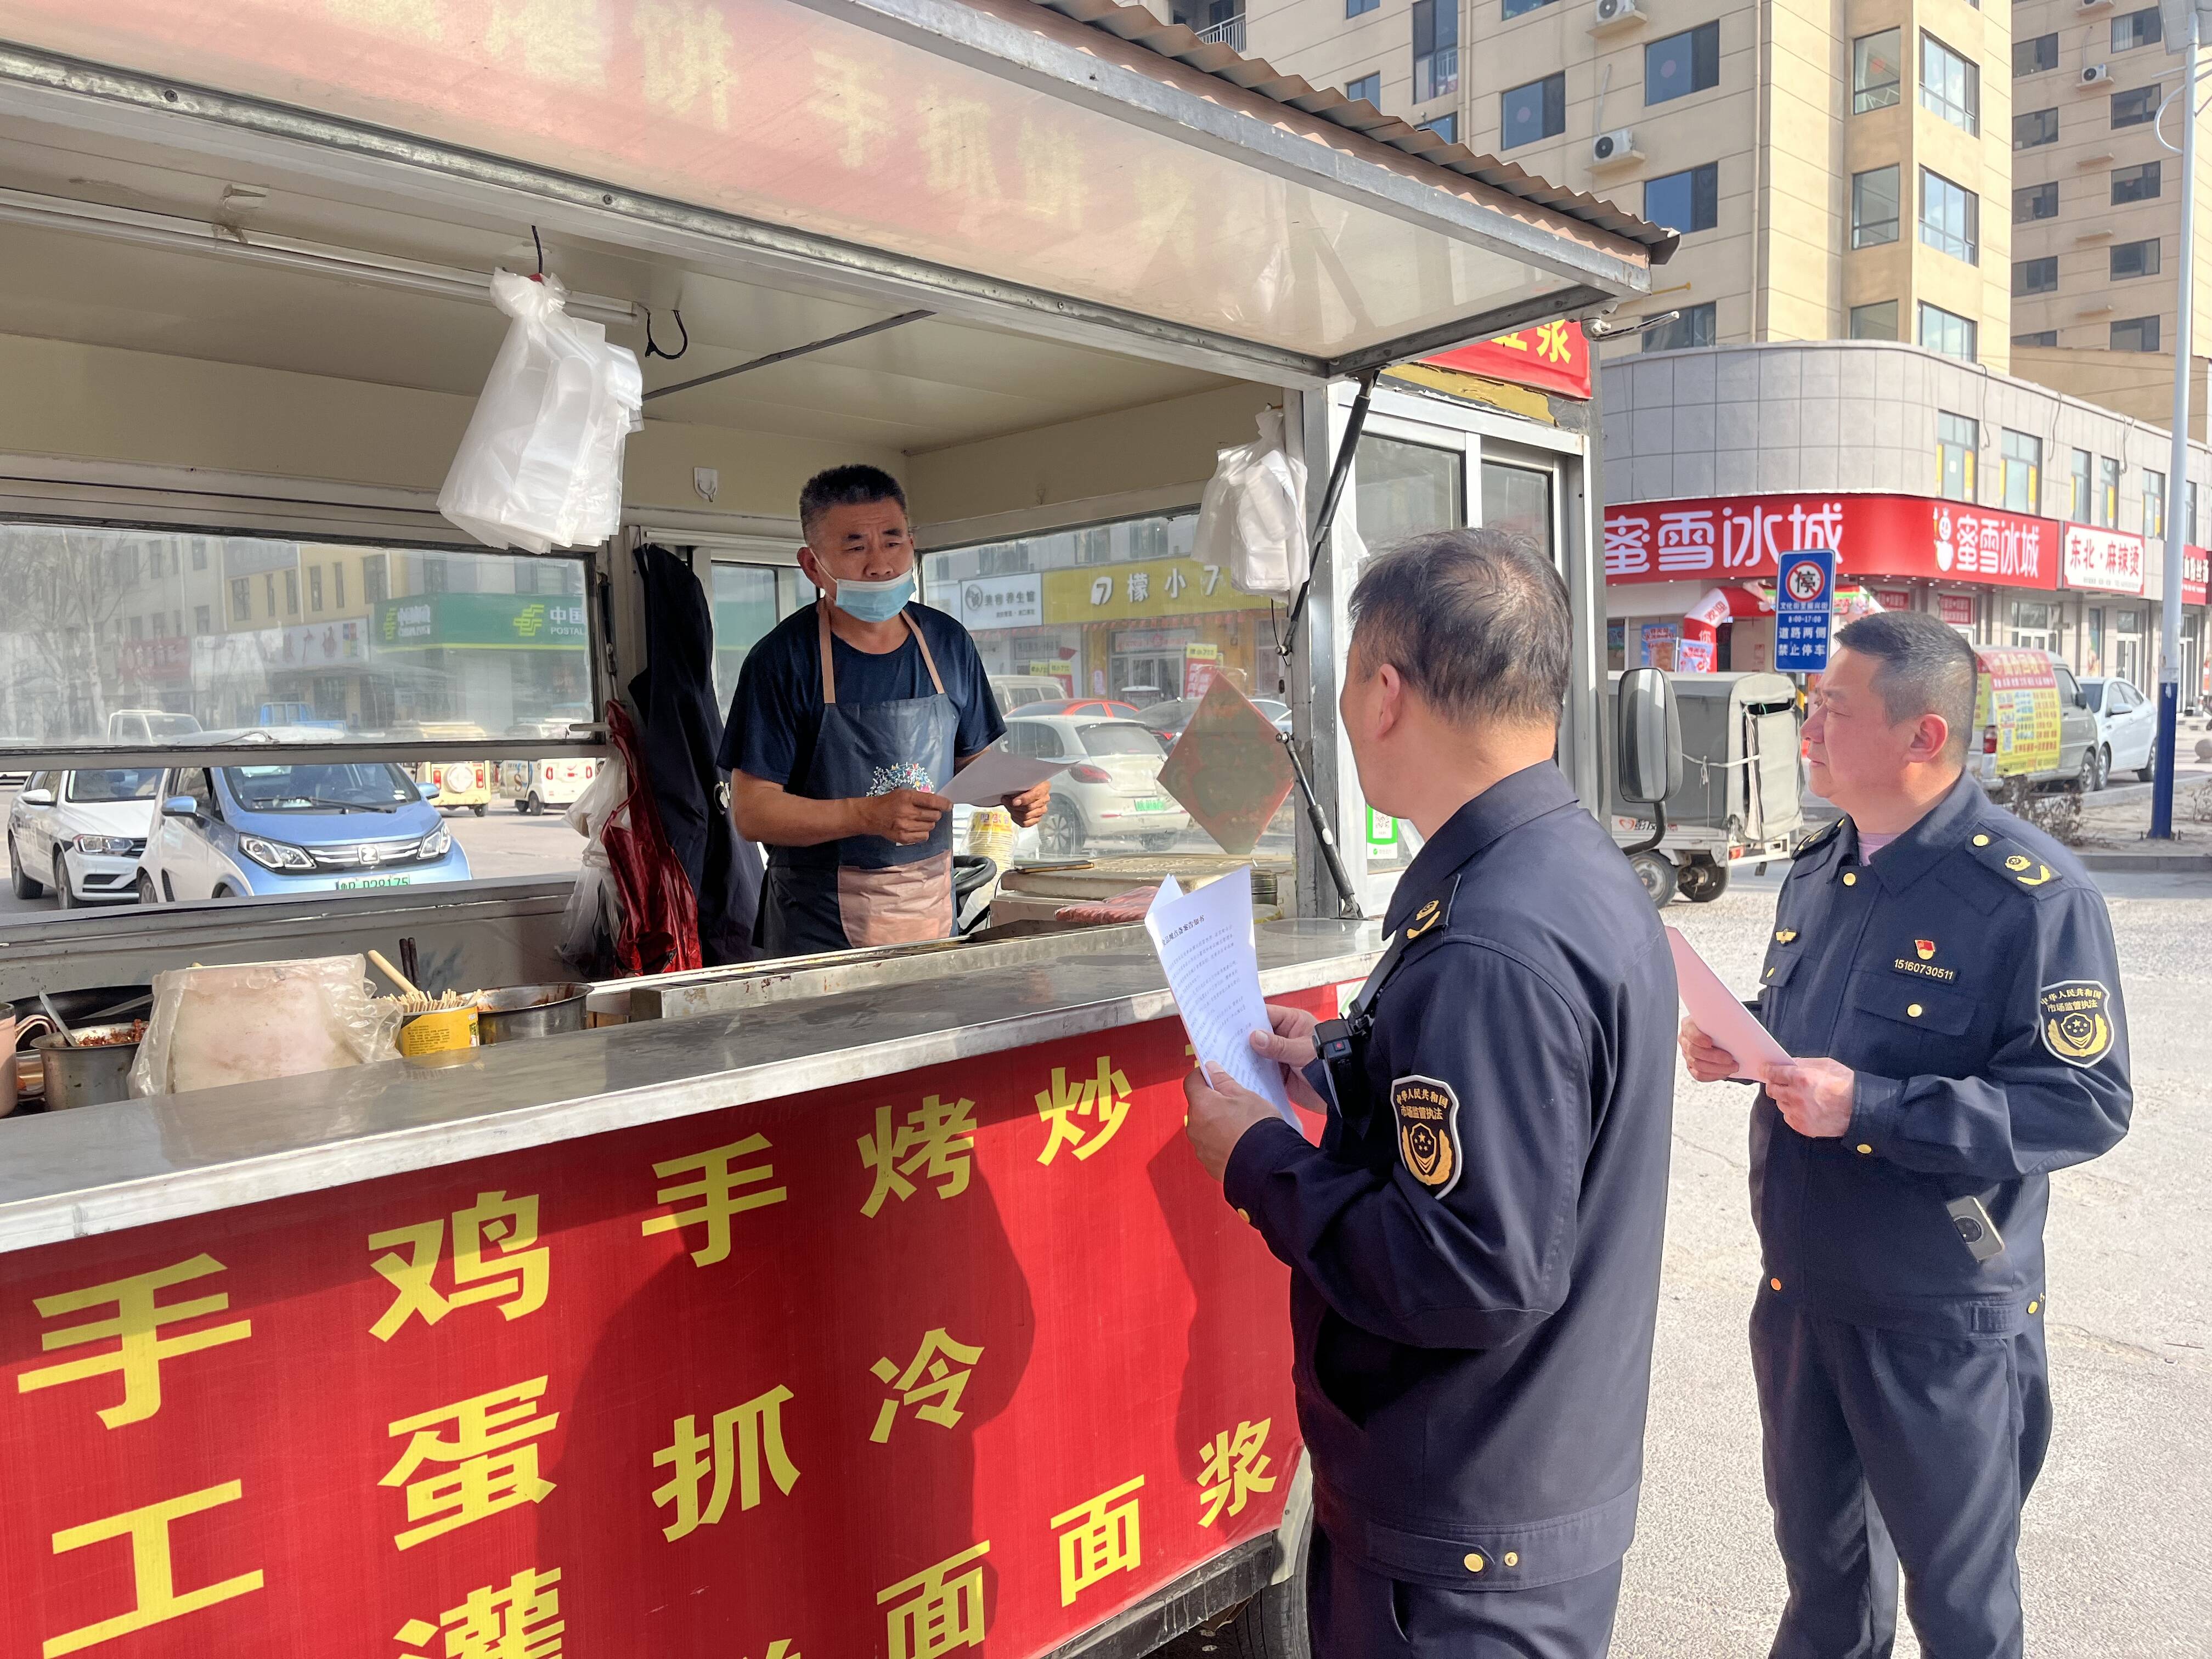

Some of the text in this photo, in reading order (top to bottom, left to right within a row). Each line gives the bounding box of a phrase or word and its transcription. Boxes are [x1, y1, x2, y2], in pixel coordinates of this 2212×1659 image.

[1605, 503, 1843, 575] 蜜雪冰城
[1956, 514, 2040, 579] 蜜雪冰城
[1779, 627, 1827, 639] 道路两侧
[1778, 644, 1826, 656] 禁止停车
[1894, 958, 1954, 980] 15160730511
[2041, 988, 2102, 1005] 中华人民共和国
[2047, 999, 2098, 1013] 市场监管执法
[1396, 1088, 1448, 1109] 中华人民共和国
[1400, 1104, 1443, 1120] 市场监管执法
